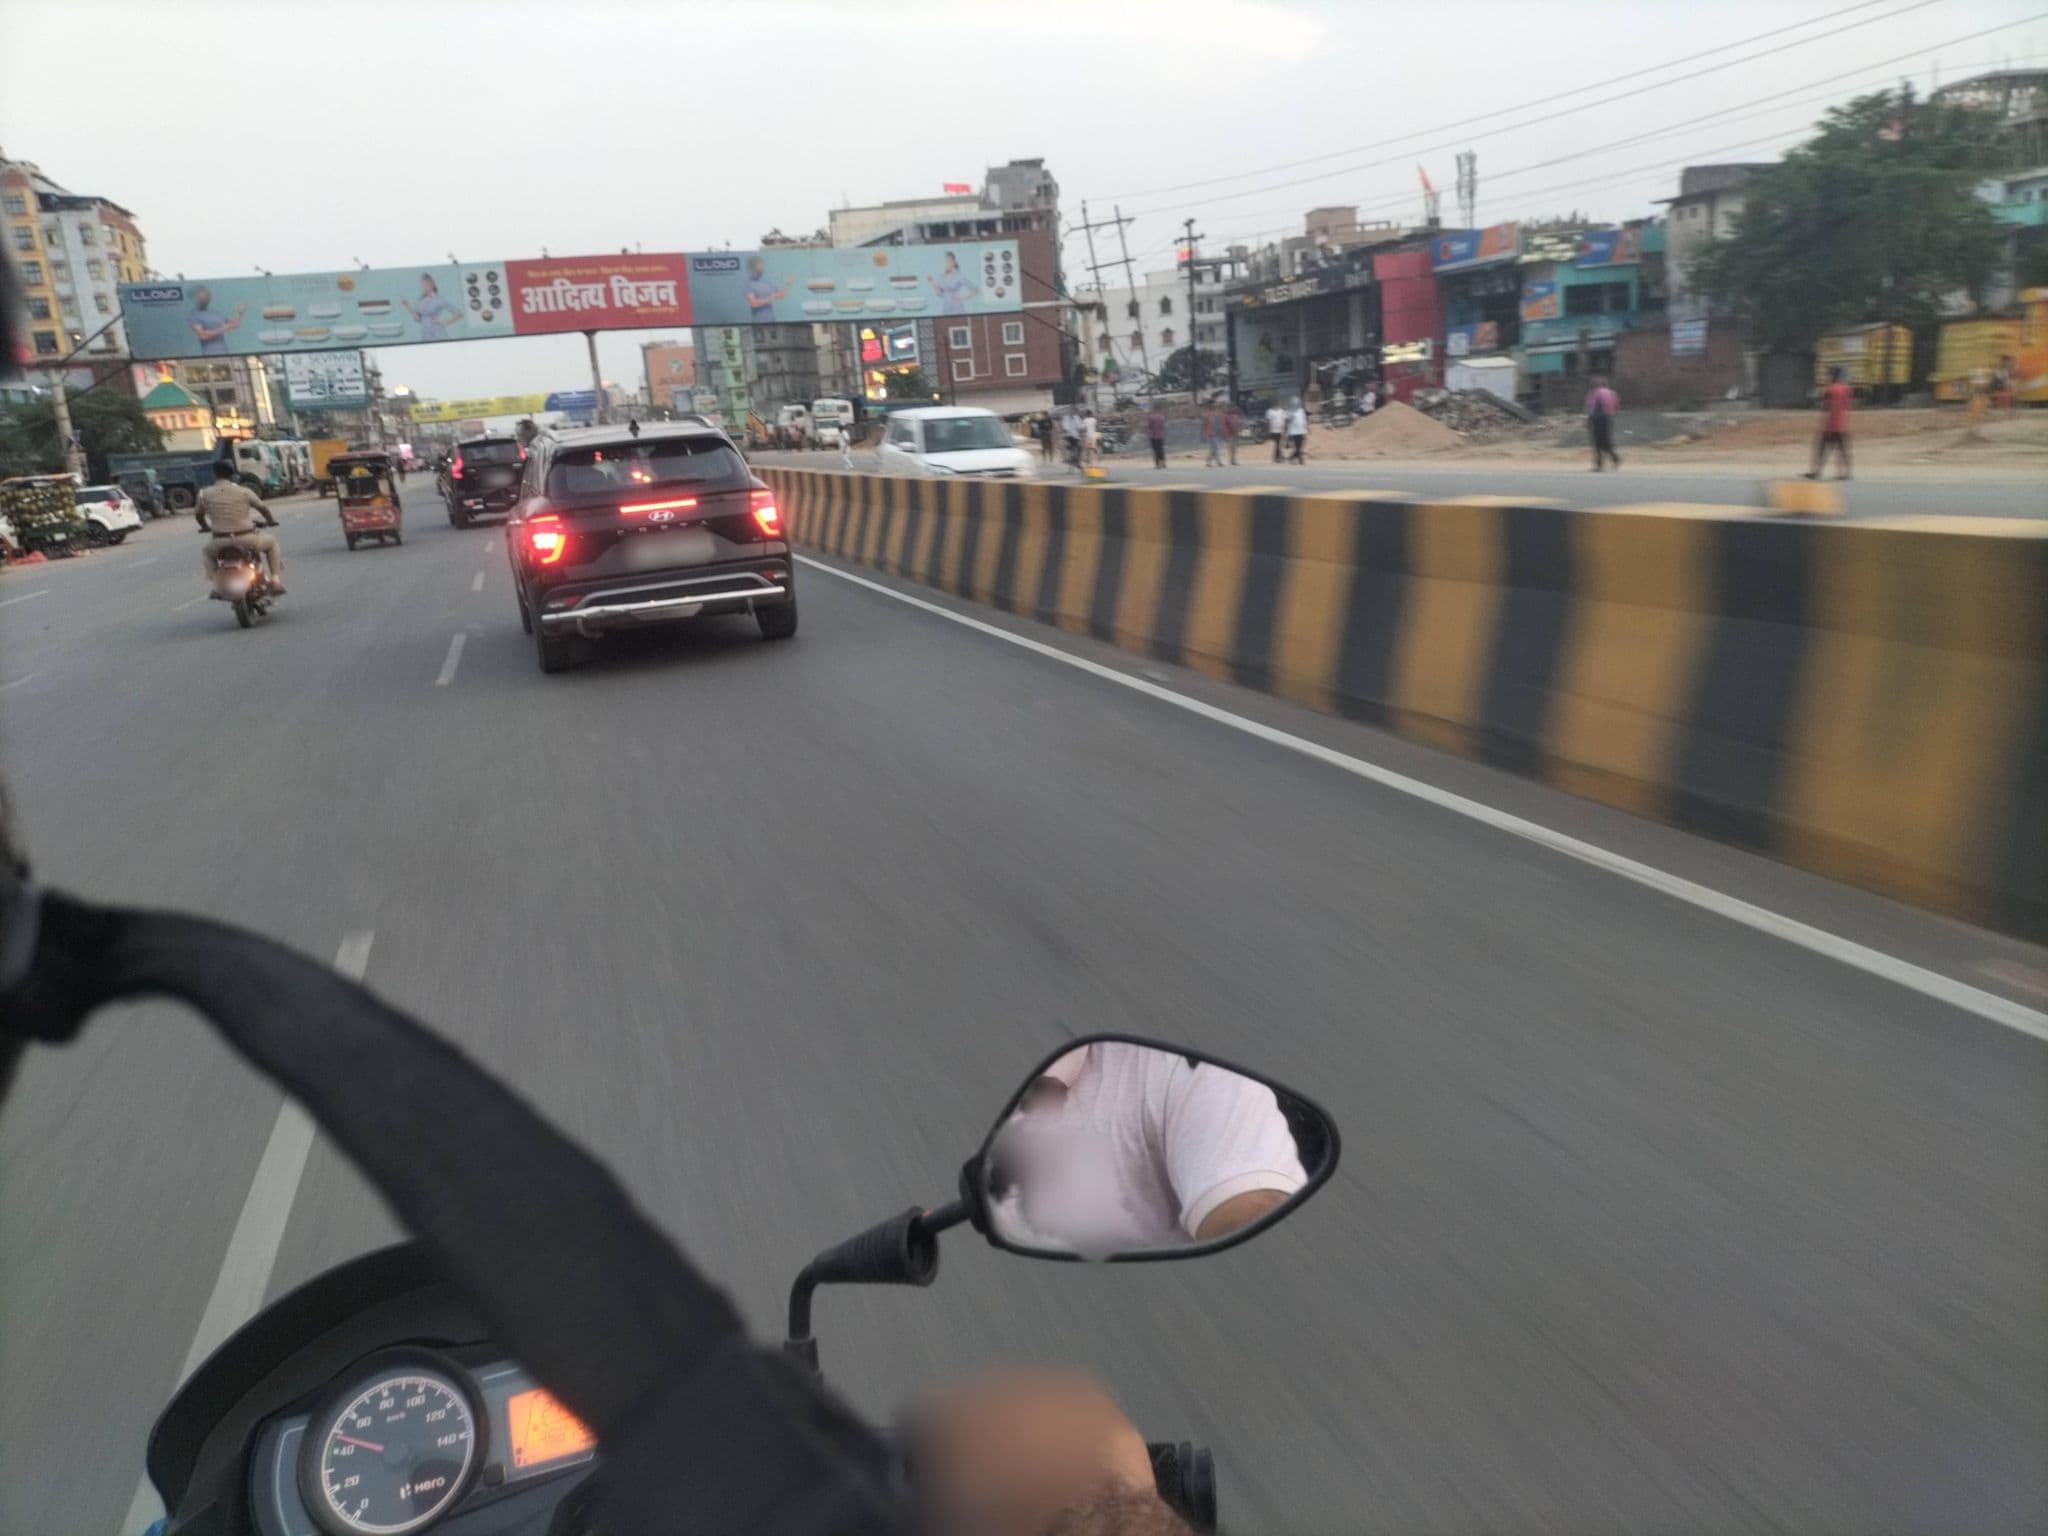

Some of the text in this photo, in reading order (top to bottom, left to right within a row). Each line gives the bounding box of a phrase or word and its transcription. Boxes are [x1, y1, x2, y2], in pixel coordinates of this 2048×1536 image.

[695, 259, 738, 270] LLOYD
[131, 288, 180, 300] LLOYD
[520, 277, 608, 313] आदित्य
[406, 1395, 426, 1408] 100
[426, 1409, 445, 1423] 120
[437, 1433, 457, 1448] 140
[340, 1445, 355, 1456] 40
[344, 1475, 360, 1488] 20
[360, 1498, 369, 1509] 0
